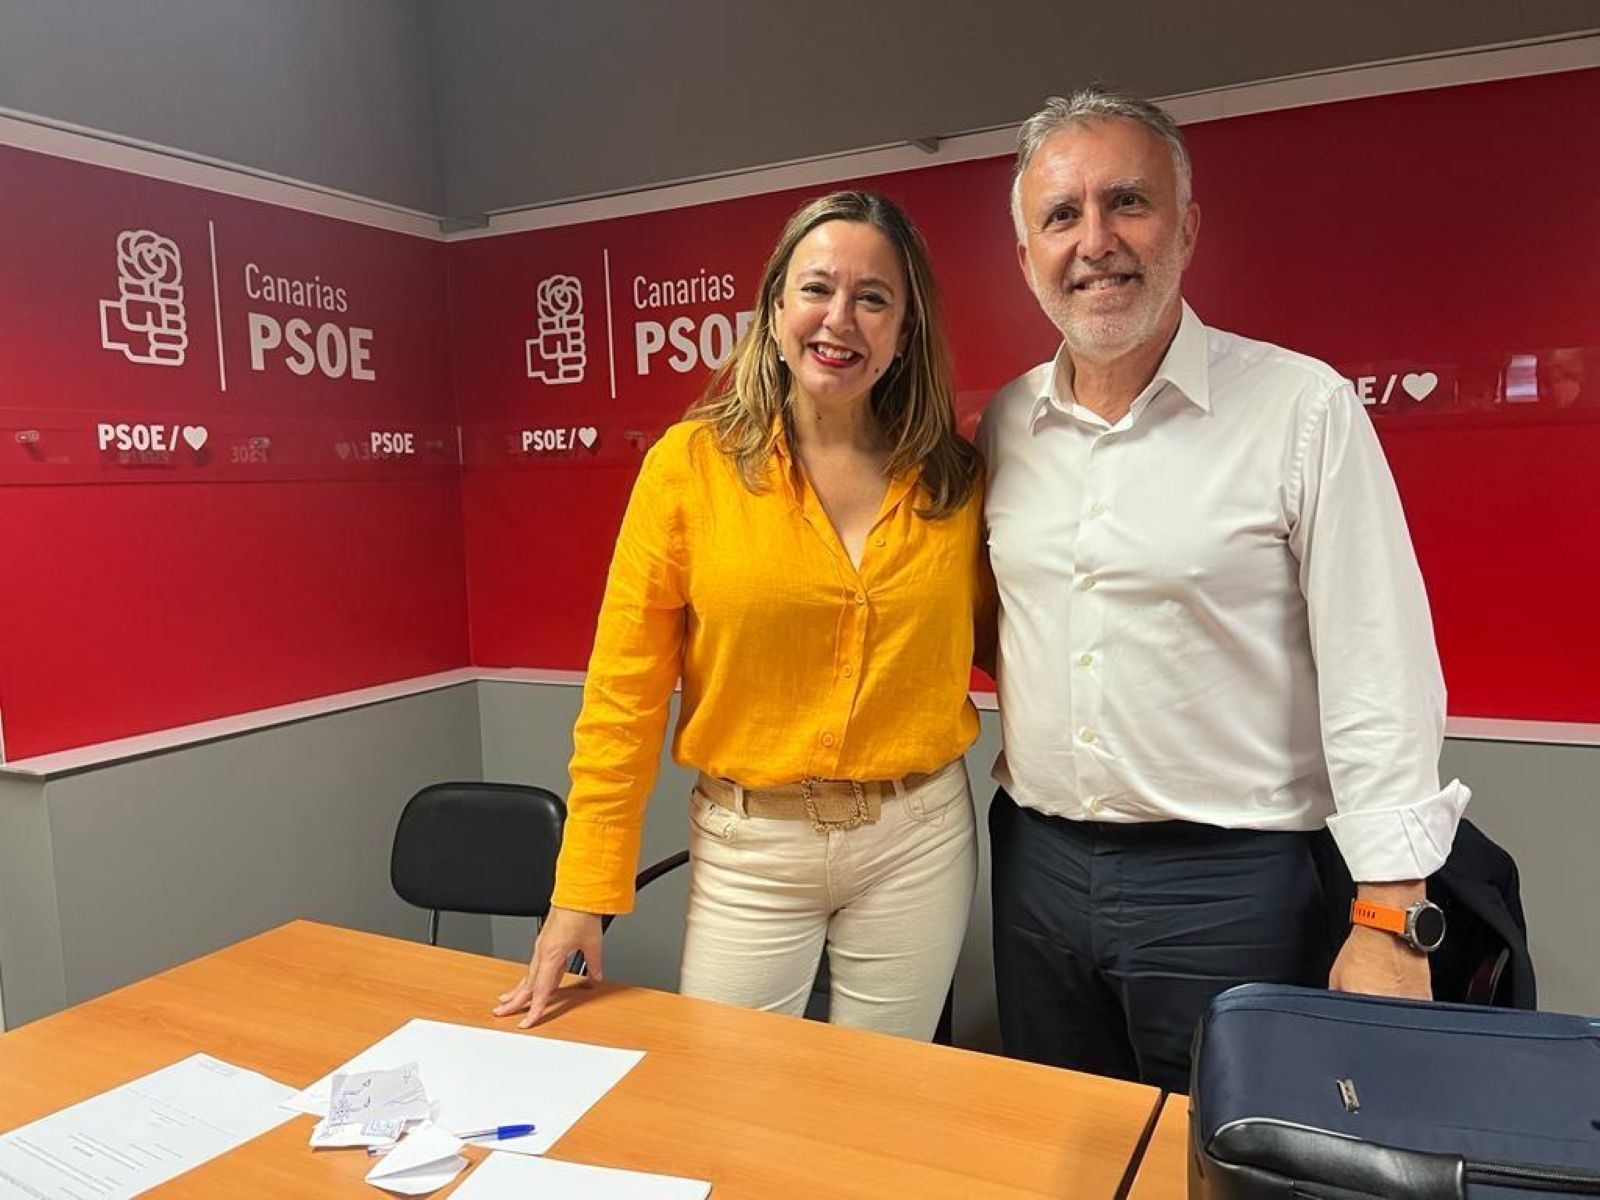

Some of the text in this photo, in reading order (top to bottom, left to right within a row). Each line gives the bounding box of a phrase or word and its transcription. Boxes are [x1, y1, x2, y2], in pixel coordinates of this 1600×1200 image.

[245, 263, 348, 313] Canarias
[633, 269, 735, 309] Canarias
[248, 312, 376, 381] PSOE
[371, 432, 415, 454] PSOE
